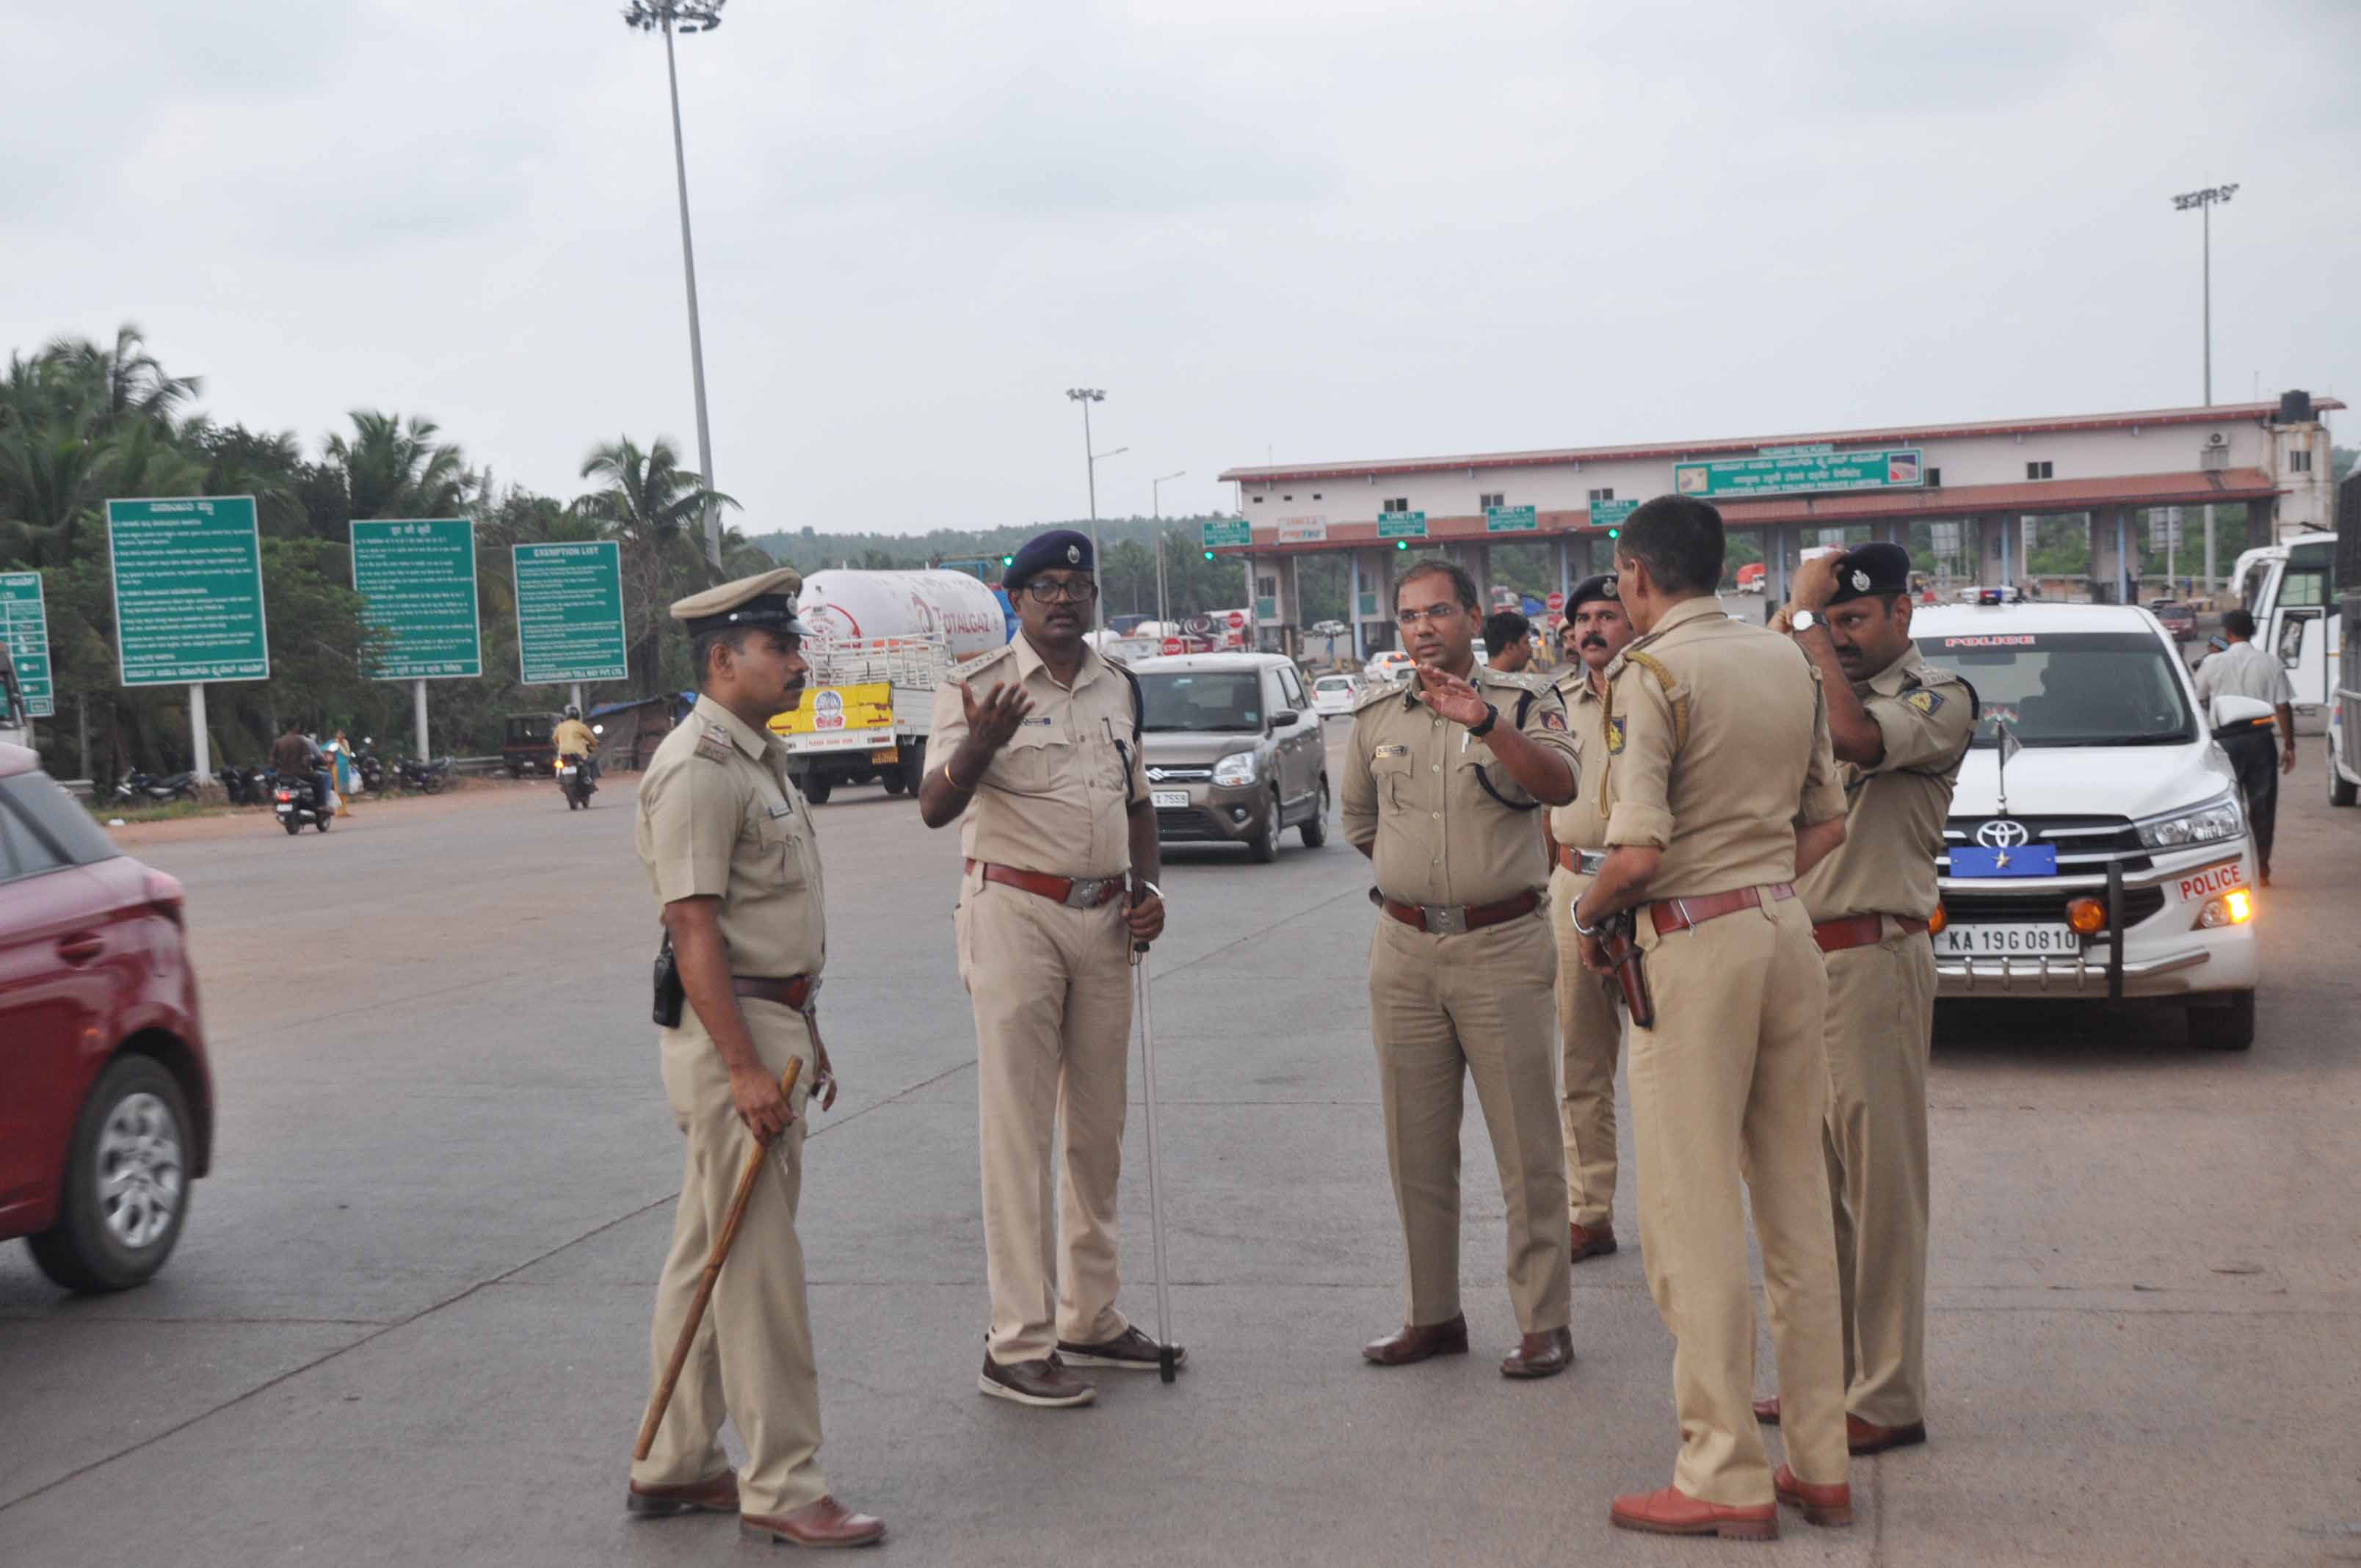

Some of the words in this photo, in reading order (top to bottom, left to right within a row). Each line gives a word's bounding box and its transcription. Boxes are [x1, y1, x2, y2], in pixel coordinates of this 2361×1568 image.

[534, 548, 580, 557] EXEMPTION
[581, 546, 599, 556] LIST
[932, 606, 991, 634] TOTALGAZ
[1163, 644, 1181, 652] STOP
[1945, 635, 2035, 647] POLICE
[2181, 865, 2241, 899] POLICE
[1949, 931, 1973, 950] KA
